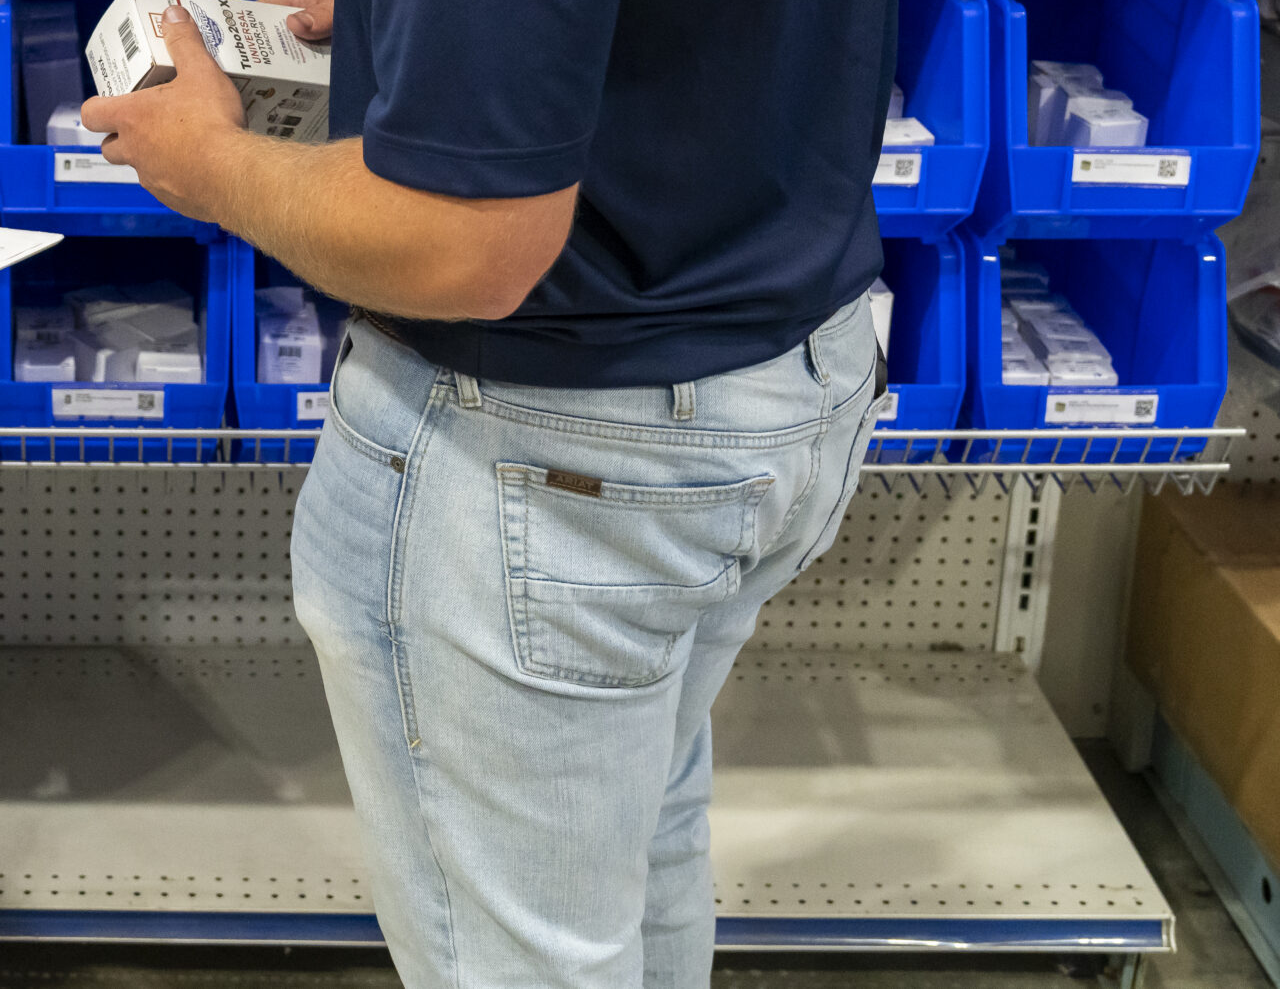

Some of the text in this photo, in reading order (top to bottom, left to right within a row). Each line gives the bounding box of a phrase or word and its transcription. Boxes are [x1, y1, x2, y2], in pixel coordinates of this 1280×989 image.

[236, 9, 262, 64] UNIVERSAL
[245, 9, 272, 65] MOTOR-RUN
[258, 21, 275, 56] CAPACITOR
[556, 474, 594, 490] ARIAT
